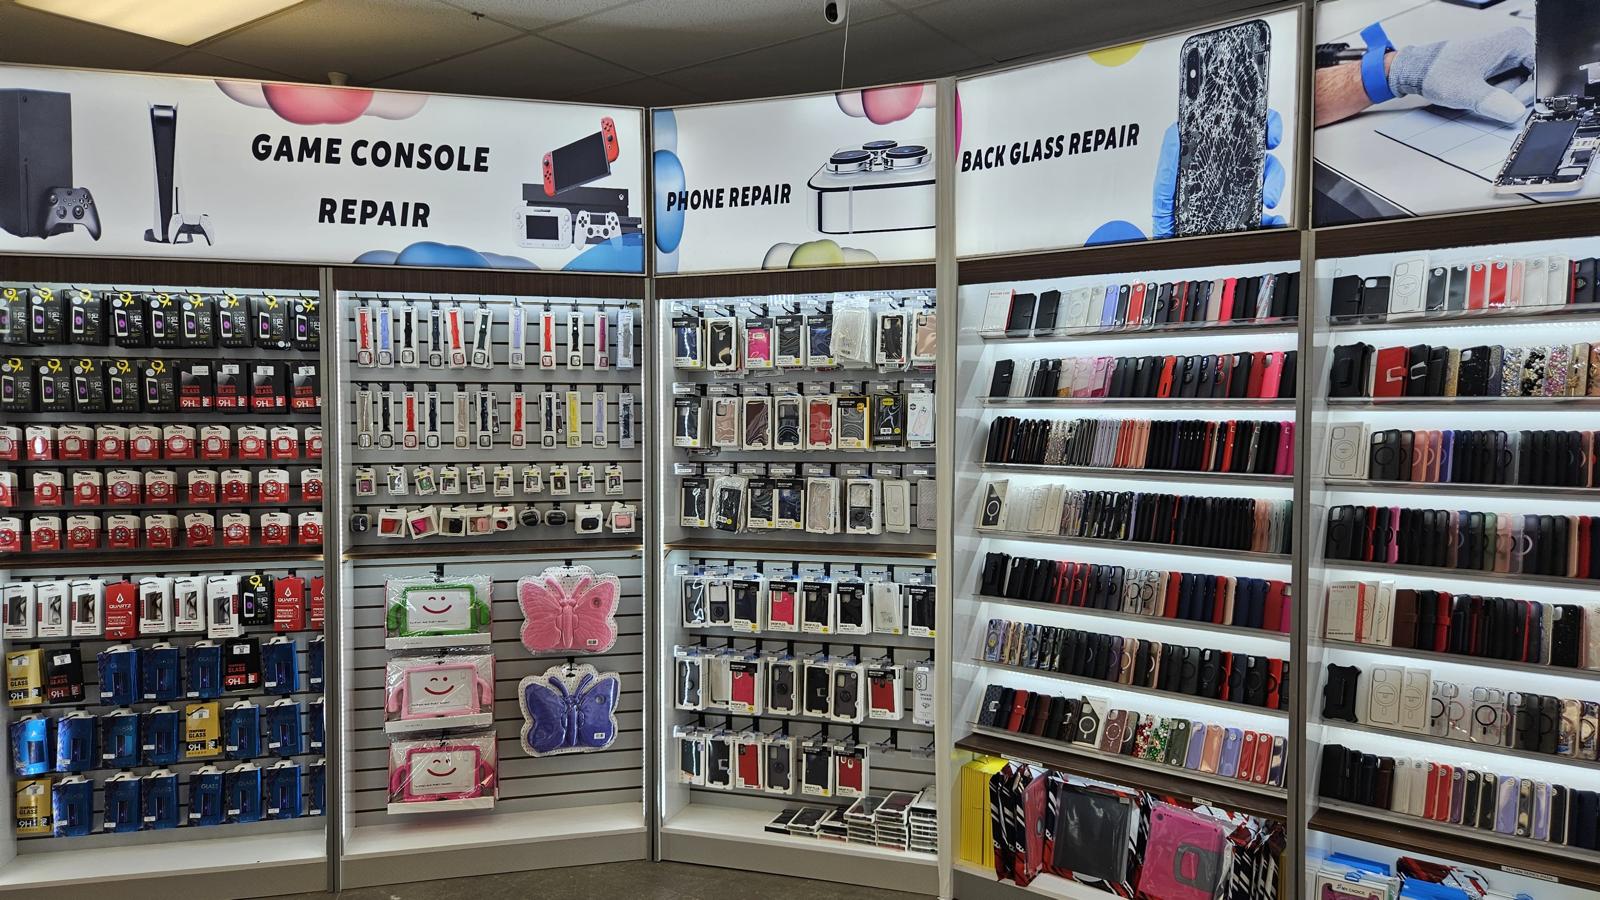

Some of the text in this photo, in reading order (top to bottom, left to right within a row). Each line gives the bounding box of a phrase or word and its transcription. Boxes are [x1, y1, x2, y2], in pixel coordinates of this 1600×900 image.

[252, 134, 489, 172] GAME CONSOLE
[962, 124, 1139, 172] BACK GLASS REPAIR
[666, 184, 791, 211] PHONE REPAIR
[319, 198, 430, 227] REPAIR
[182, 399, 195, 407] 9H
[218, 399, 231, 407] 9H
[11, 692, 23, 700] 9H
[51, 690, 64, 698] 9H
